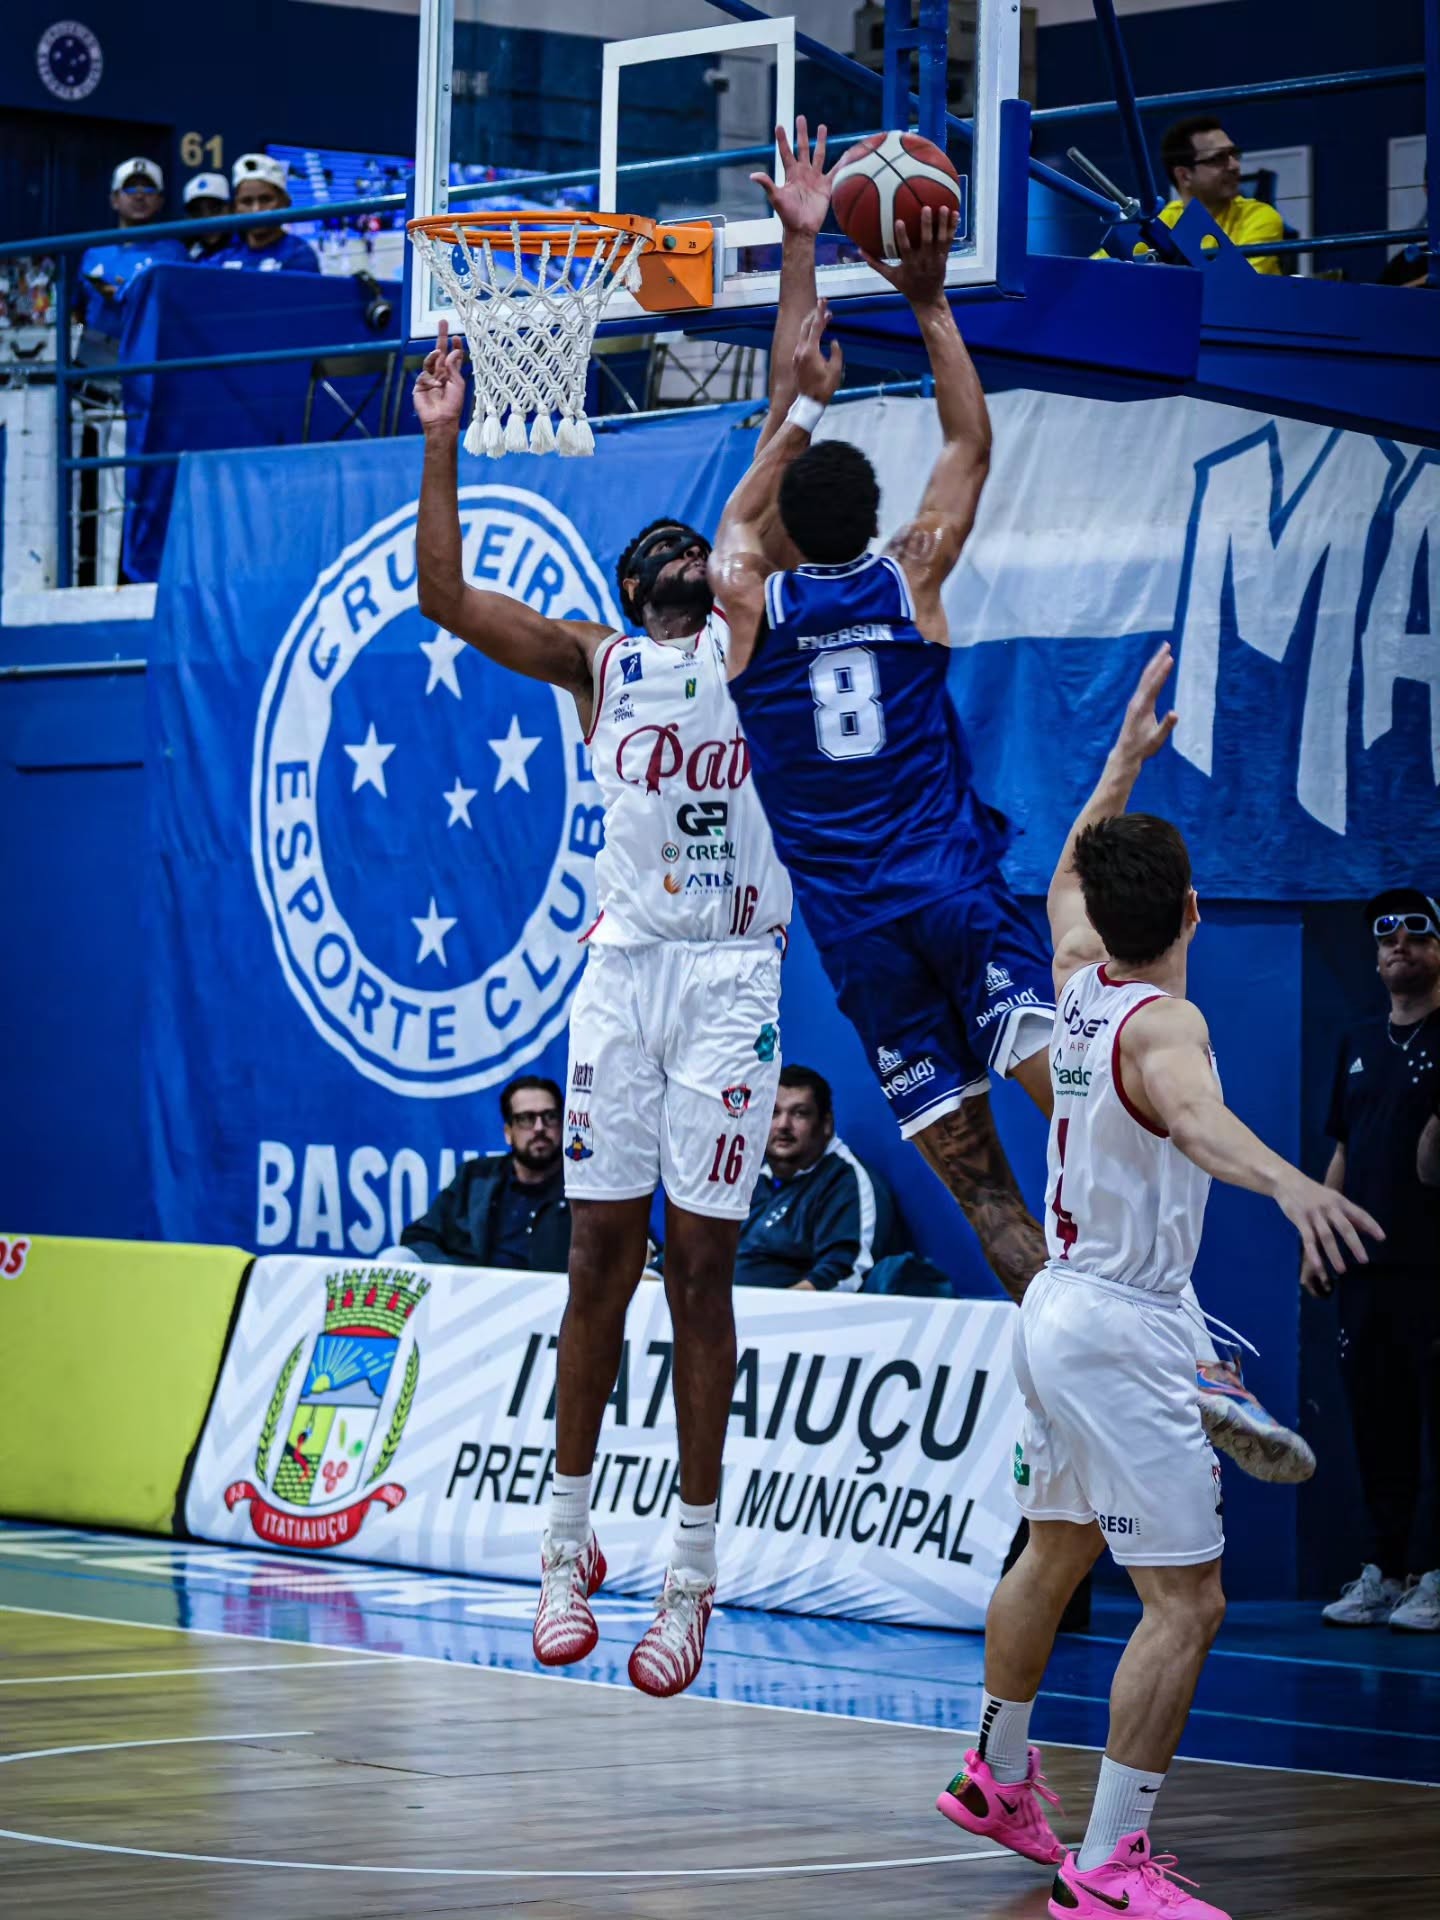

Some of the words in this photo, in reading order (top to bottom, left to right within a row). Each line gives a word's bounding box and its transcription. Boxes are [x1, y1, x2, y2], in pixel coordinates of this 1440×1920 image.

[181, 132, 224, 169] 61
[309, 521, 591, 681] CRUEIR
[809, 645, 887, 761] 8
[616, 722, 751, 795] Pat
[275, 760, 456, 1060] ESPORTE
[729, 885, 758, 936] 16
[257, 1140, 508, 1254] BASQ
[708, 1133, 745, 1184] 16
[507, 1333, 989, 1475] IATAIUÇU
[262, 1512, 348, 1543] ITATIAIUÇU
[446, 1442, 724, 1523] PREFITU
[735, 1469, 975, 1565] MUNICIPAL
[1100, 1515, 1133, 1534] SESI
